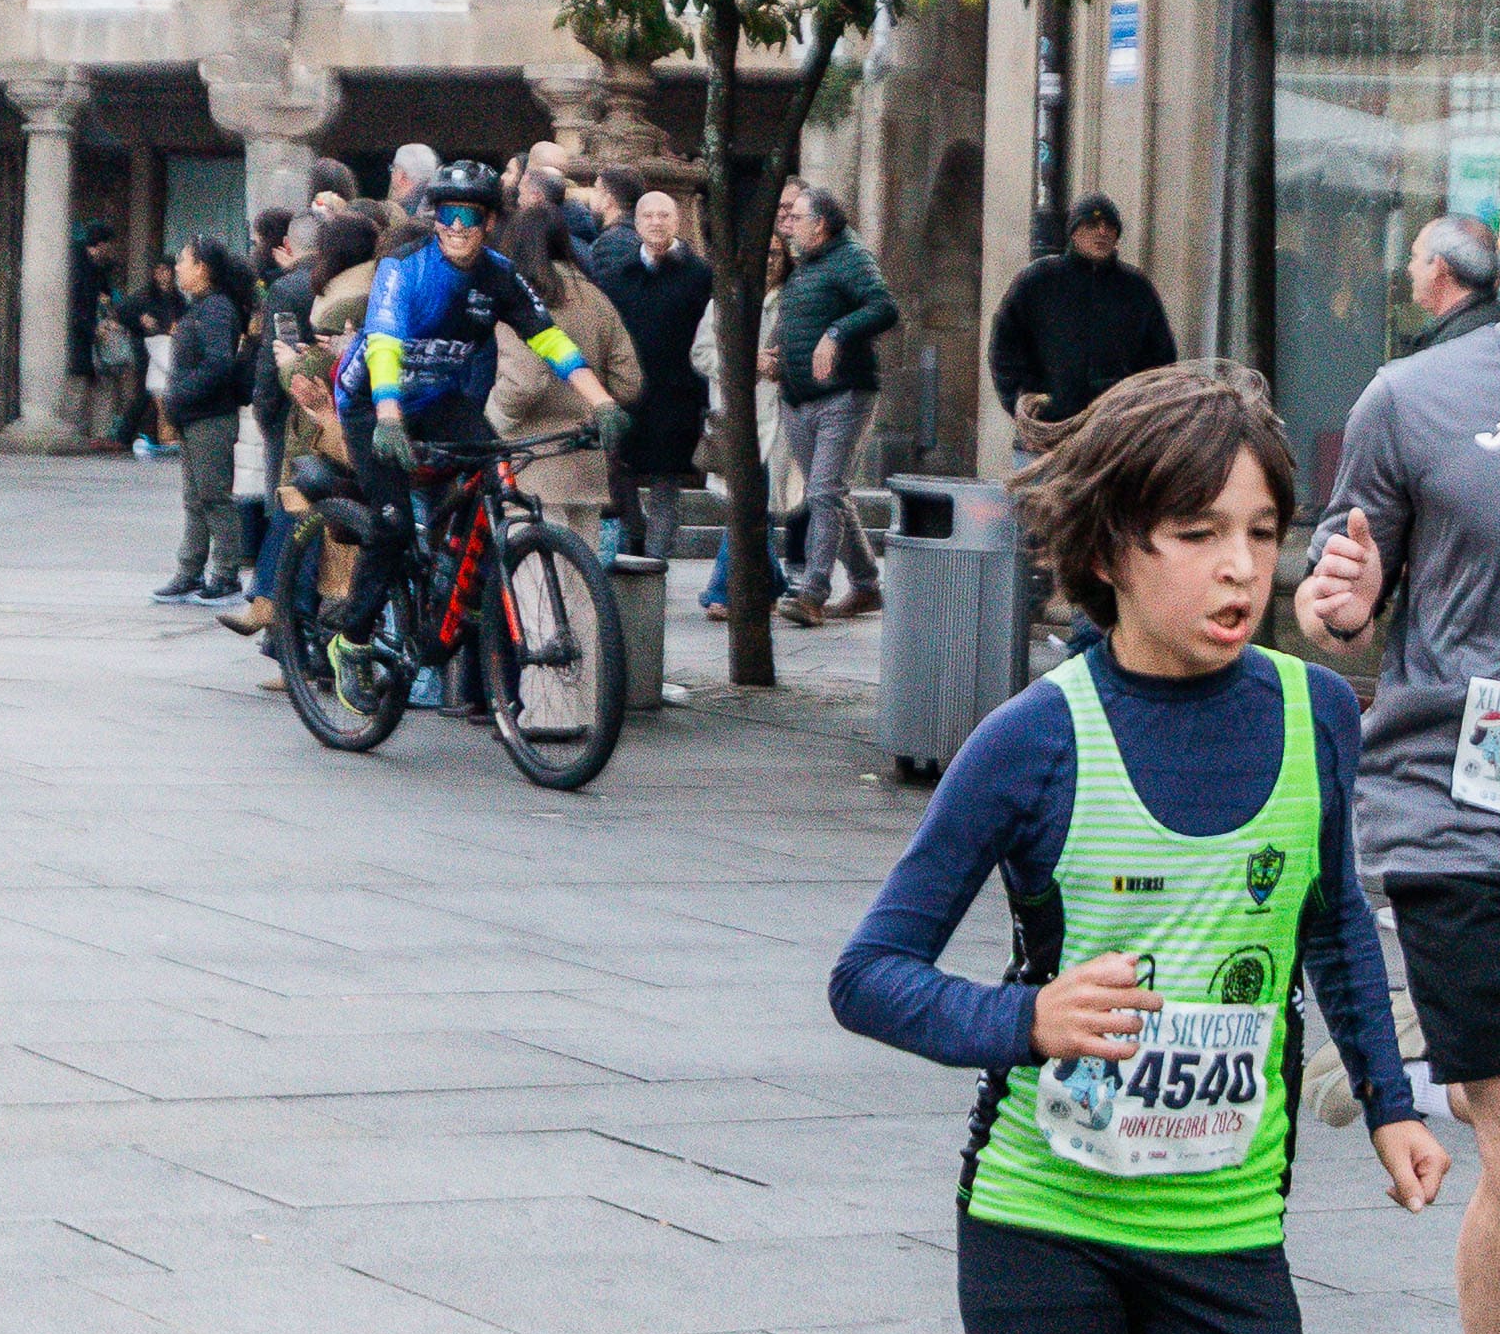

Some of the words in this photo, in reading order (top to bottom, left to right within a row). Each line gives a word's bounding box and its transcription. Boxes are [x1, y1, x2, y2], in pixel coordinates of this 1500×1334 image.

[1167, 1010, 1266, 1049] SILVESTRE
[1126, 1050, 1257, 1110] 4540
[1117, 1113, 1207, 1139] PONTEVEDRA
[1211, 1110, 1246, 1135] 2025
